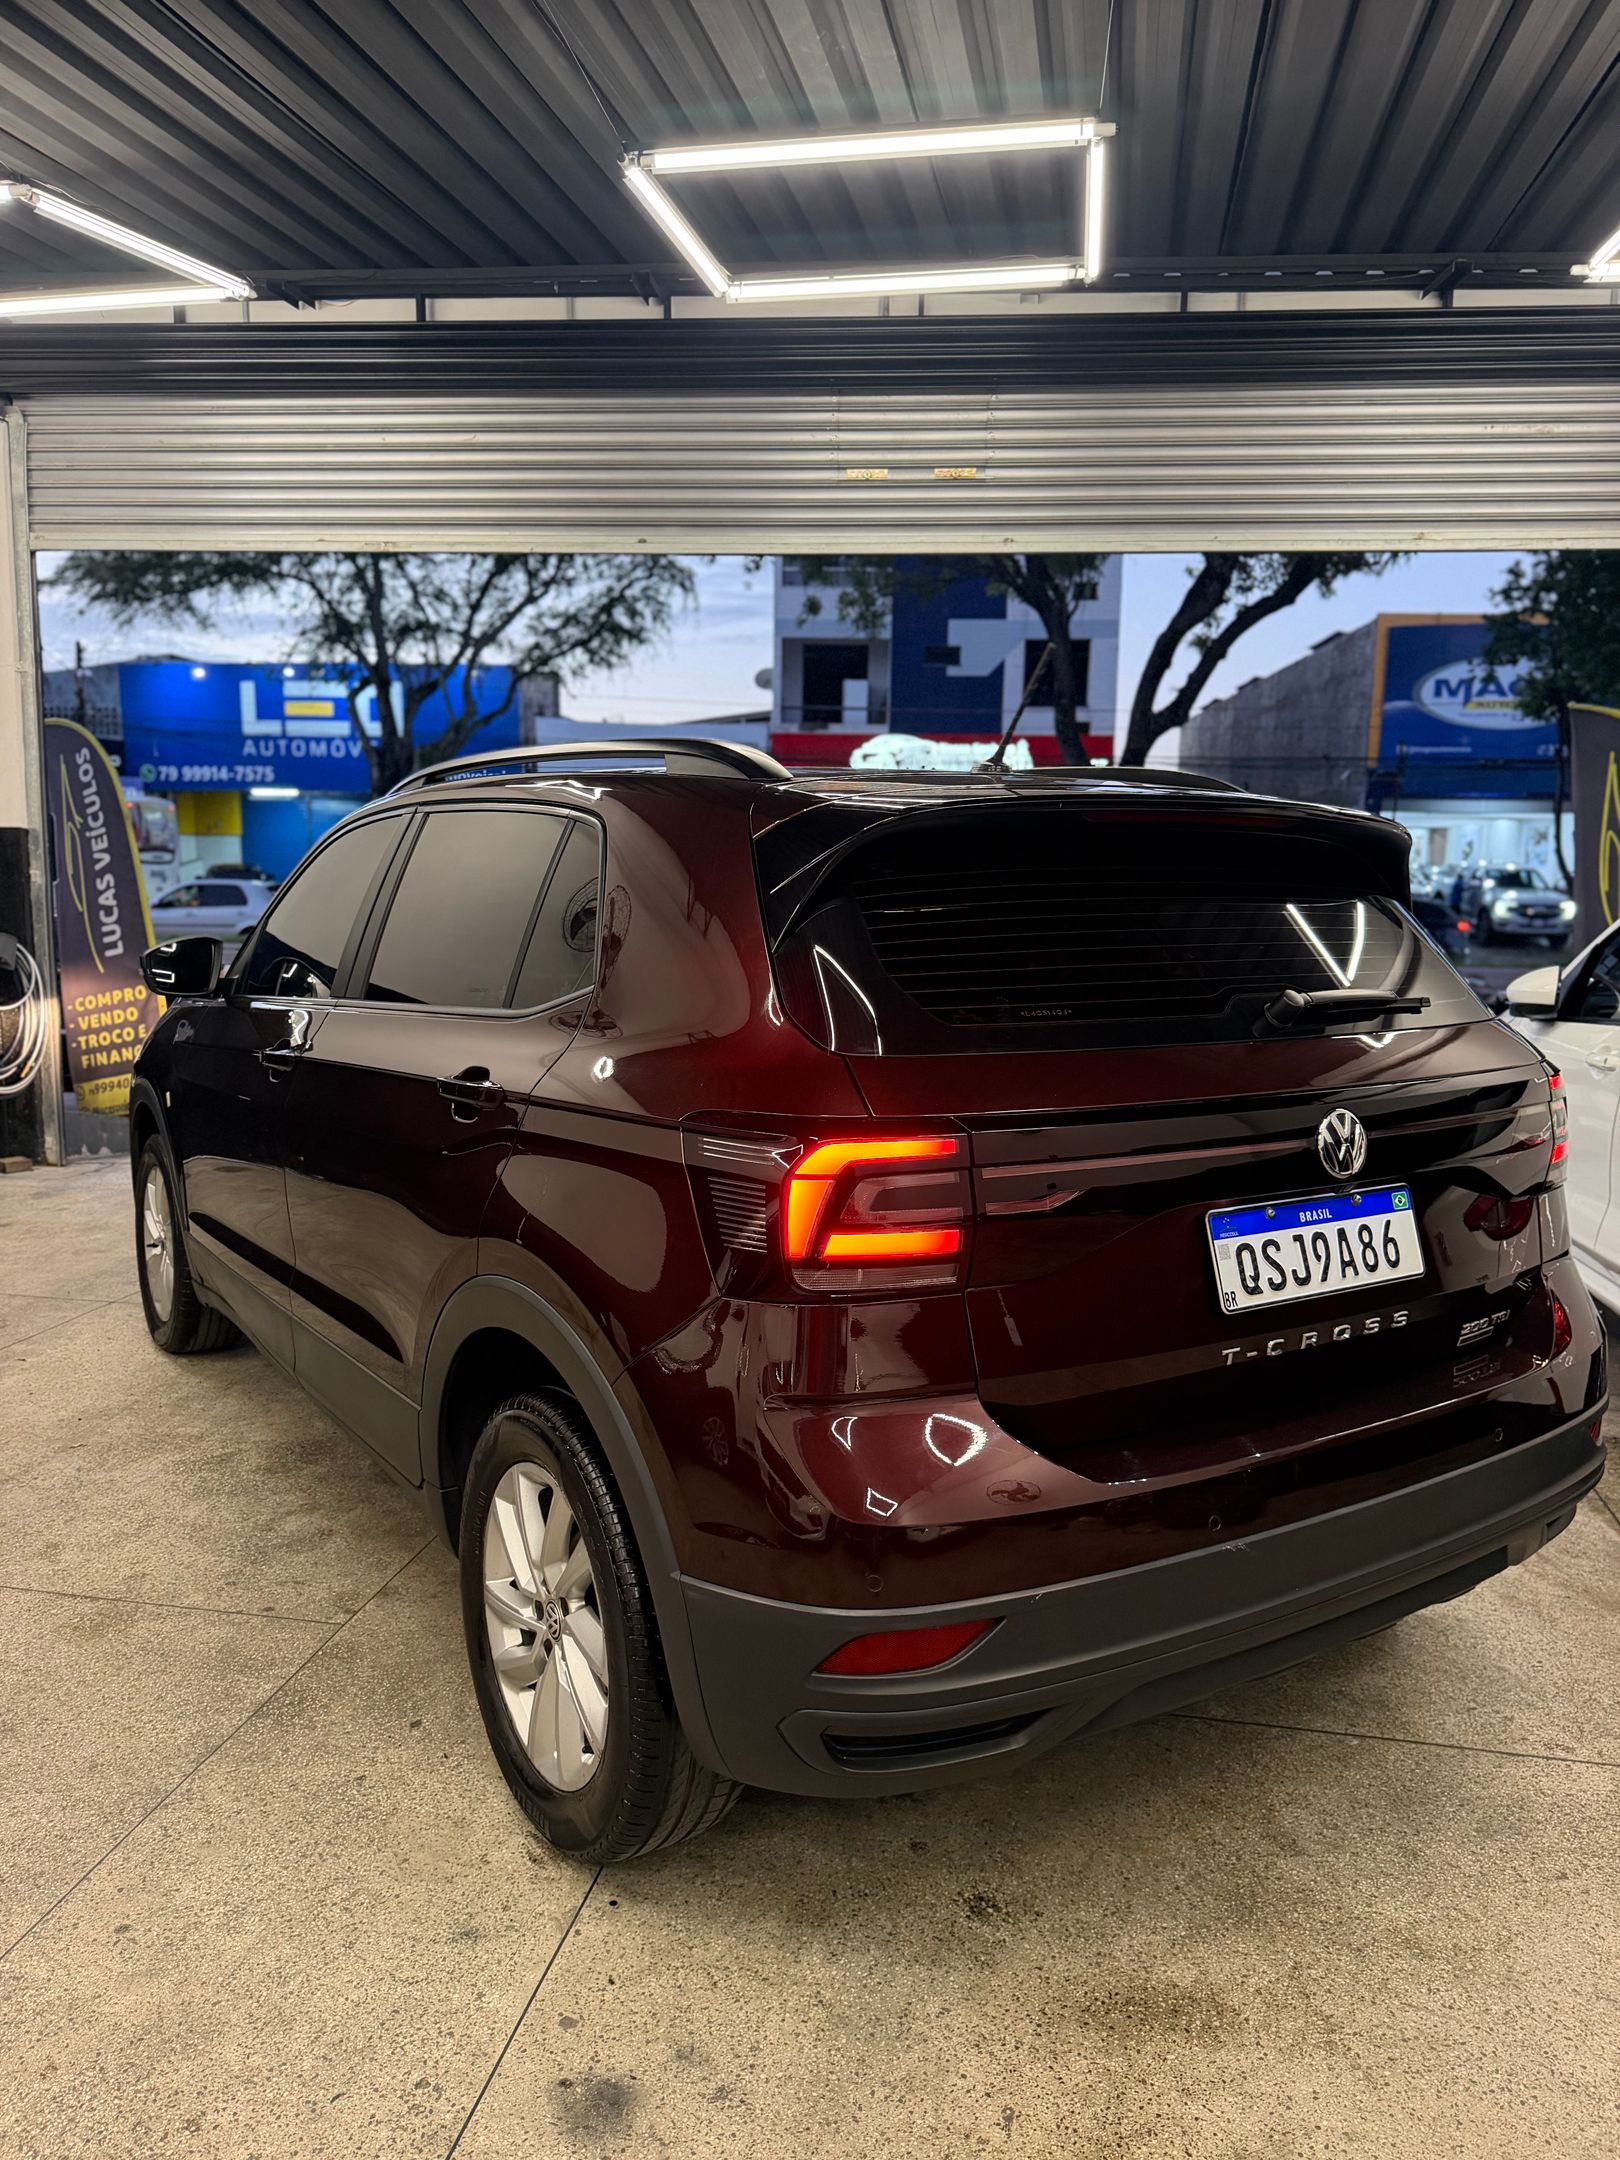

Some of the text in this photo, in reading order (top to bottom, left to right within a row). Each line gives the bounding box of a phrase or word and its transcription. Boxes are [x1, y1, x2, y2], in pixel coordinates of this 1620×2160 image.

[242, 738, 380, 758] AUTOMÓV
[158, 765, 275, 782] 79 99914-7575
[96, 874, 123, 957] LUCAS
[1299, 1208, 1333, 1223] BRASIL
[1235, 1219, 1401, 1296] QSJ9A86
[1224, 1290, 1239, 1308] BR
[1460, 1317, 1490, 1335] 200
[1221, 1310, 1409, 1366] T-CROSS
